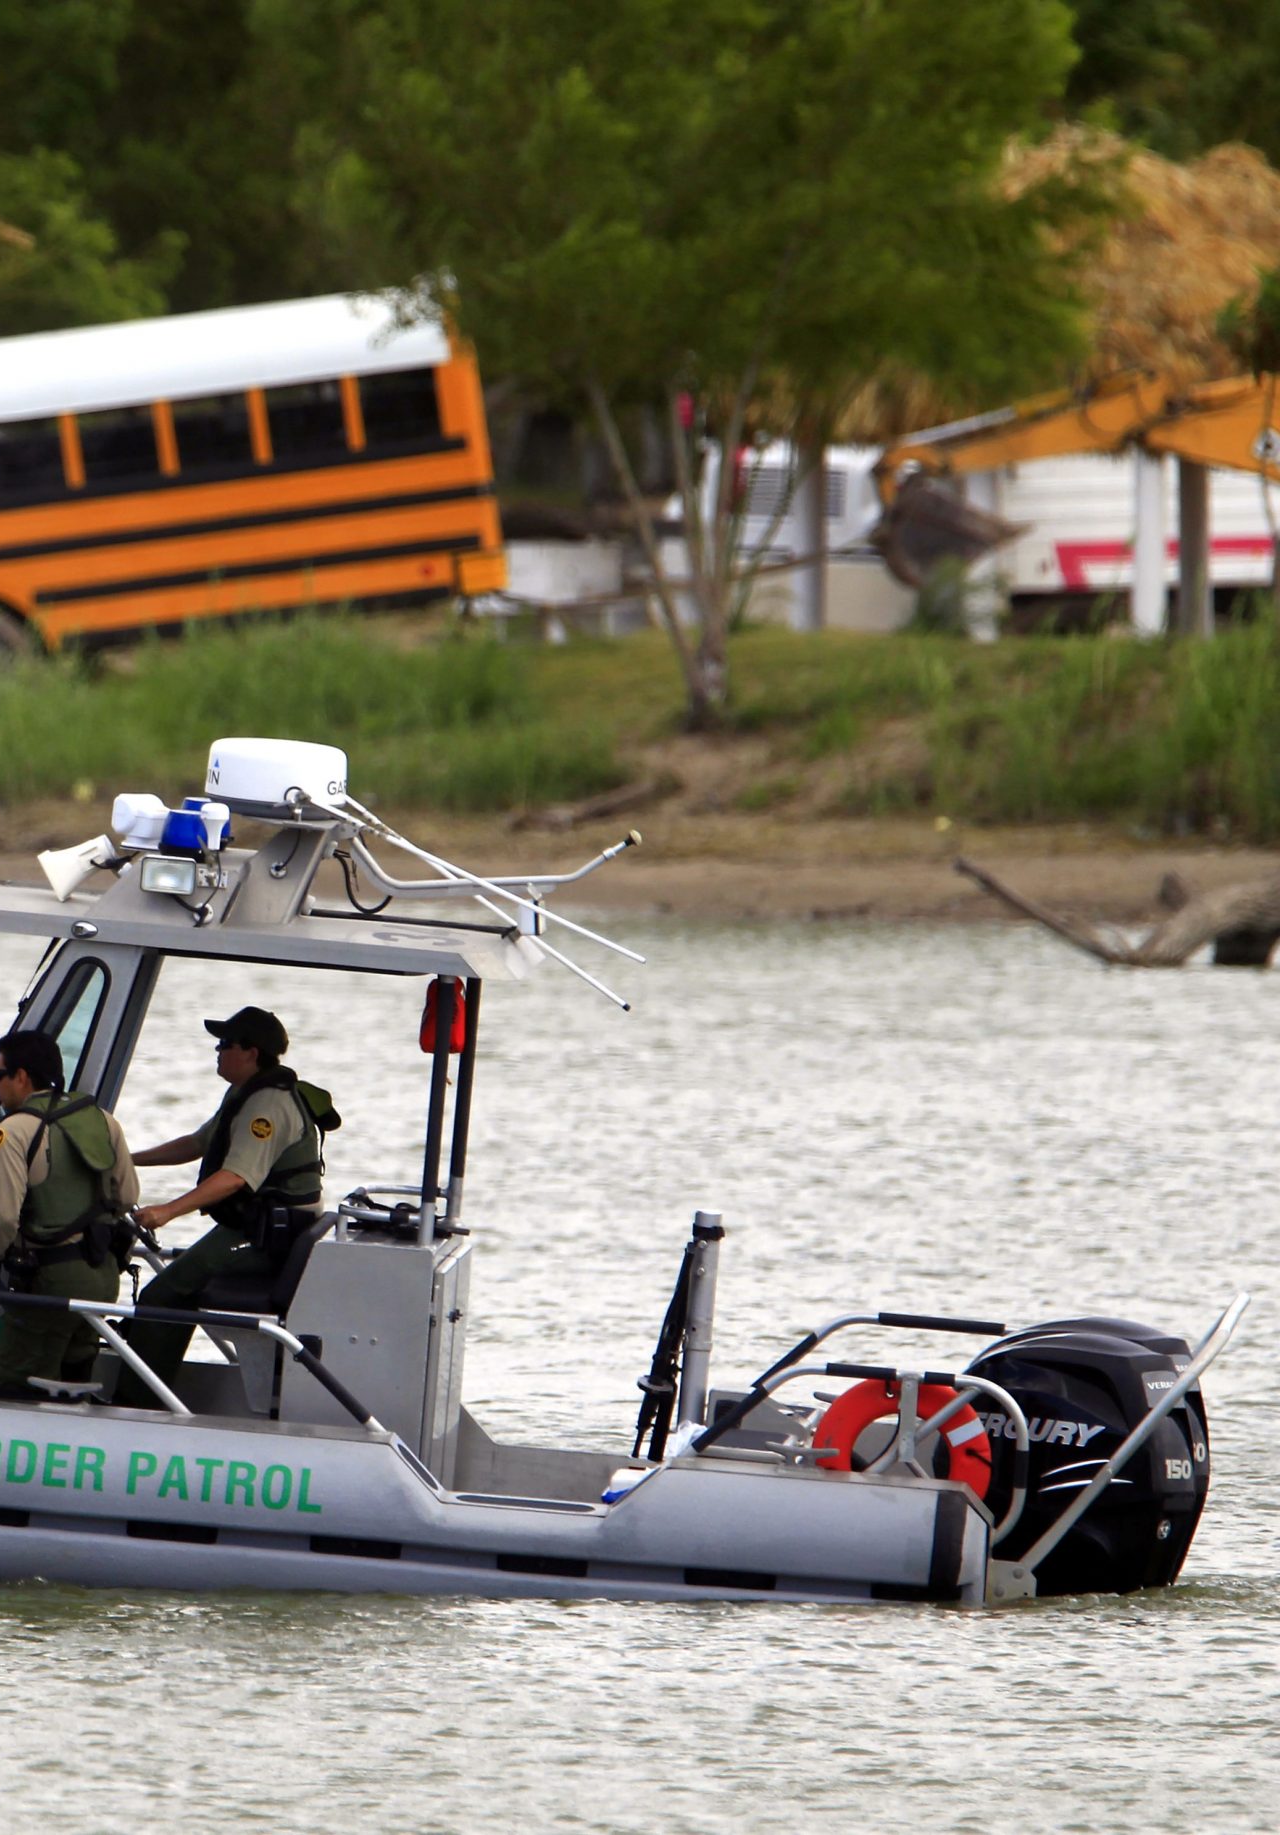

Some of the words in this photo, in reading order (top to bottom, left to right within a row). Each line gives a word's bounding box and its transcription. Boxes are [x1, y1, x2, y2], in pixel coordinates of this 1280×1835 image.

[327, 780, 347, 796] GA
[1165, 1459, 1192, 1479] 150
[126, 1451, 322, 1514] PATROL
